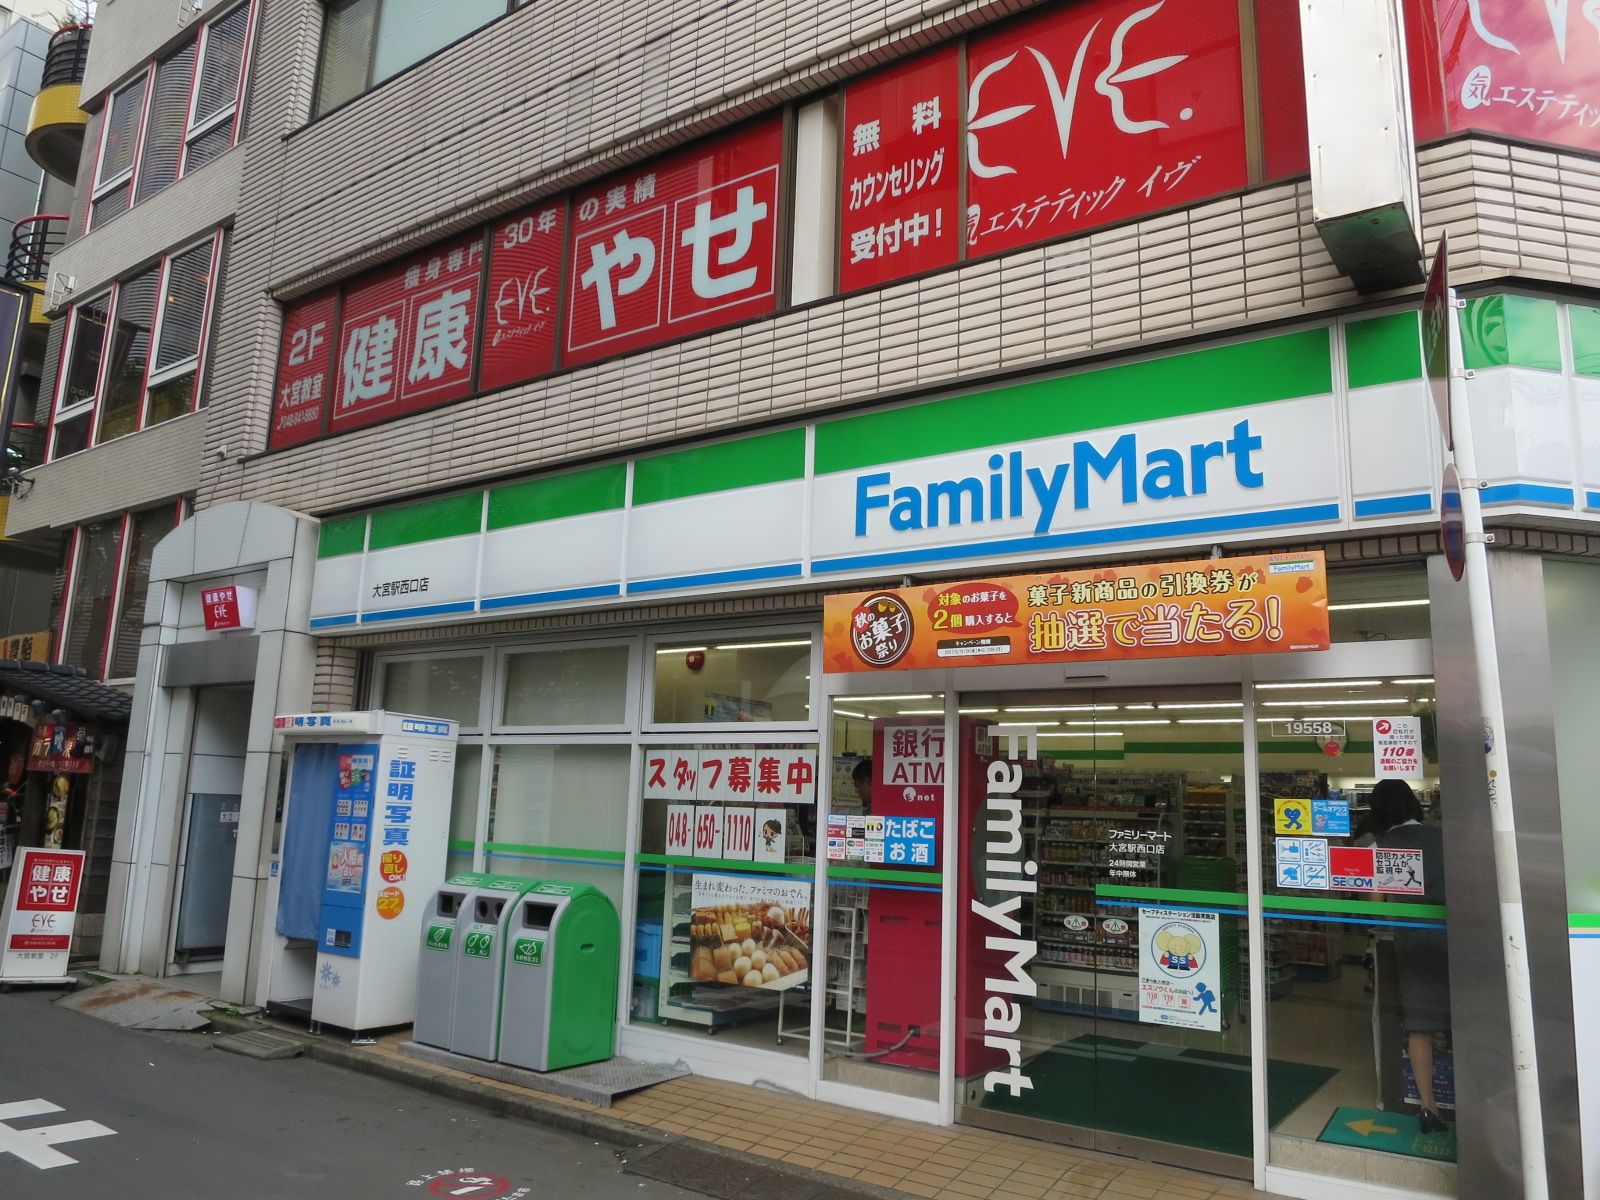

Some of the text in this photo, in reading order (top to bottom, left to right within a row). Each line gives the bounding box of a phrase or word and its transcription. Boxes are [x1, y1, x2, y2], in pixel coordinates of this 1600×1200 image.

[1465, 68, 1491, 108] 気
[852, 97, 942, 156] 無料
[849, 148, 944, 211] カウンセリング
[980, 175, 1126, 237] エステティック
[1137, 154, 1202, 198] イヴ
[504, 207, 557, 249] 30年
[579, 173, 657, 222] の実績
[850, 208, 943, 264] 受付中!
[342, 185, 768, 408] 健康 やせ
[289, 321, 327, 367] 2F
[855, 419, 1265, 537] FamilyMart
[372, 577, 429, 598] 大宮駅西口店
[938, 590, 1007, 606] 対象のお菓子を
[1027, 569, 1258, 607] 菓子新商品の引換券が
[855, 612, 875, 628] 秋の
[933, 609, 1013, 630] 2個購入すると
[1029, 595, 1283, 653] 抽選で当たる!
[859, 612, 906, 650] お菓子
[876, 639, 898, 658] 祭り
[1285, 723, 1332, 734] 19558
[1383, 746, 1415, 757] 110番
[648, 757, 812, 795] スタッフ募集中
[891, 762, 945, 783] ATM
[383, 760, 416, 846] 証明写真
[886, 819, 935, 839] たばこ
[1109, 830, 1172, 841] ファミリーマート
[889, 843, 929, 863] お酒
[1109, 843, 1165, 854] 大宮駅西口店
[1376, 852, 1421, 860] 防犯カメラで
[32, 865, 71, 882] 健康
[1109, 860, 1146, 868] 24時間営業
[1109, 869, 1137, 878] 年中無休
[1376, 866, 1403, 875] 監視中
[1333, 877, 1373, 888] SECOM
[30, 885, 68, 903] やせ
[971, 725, 1038, 1097] FamilyMart
